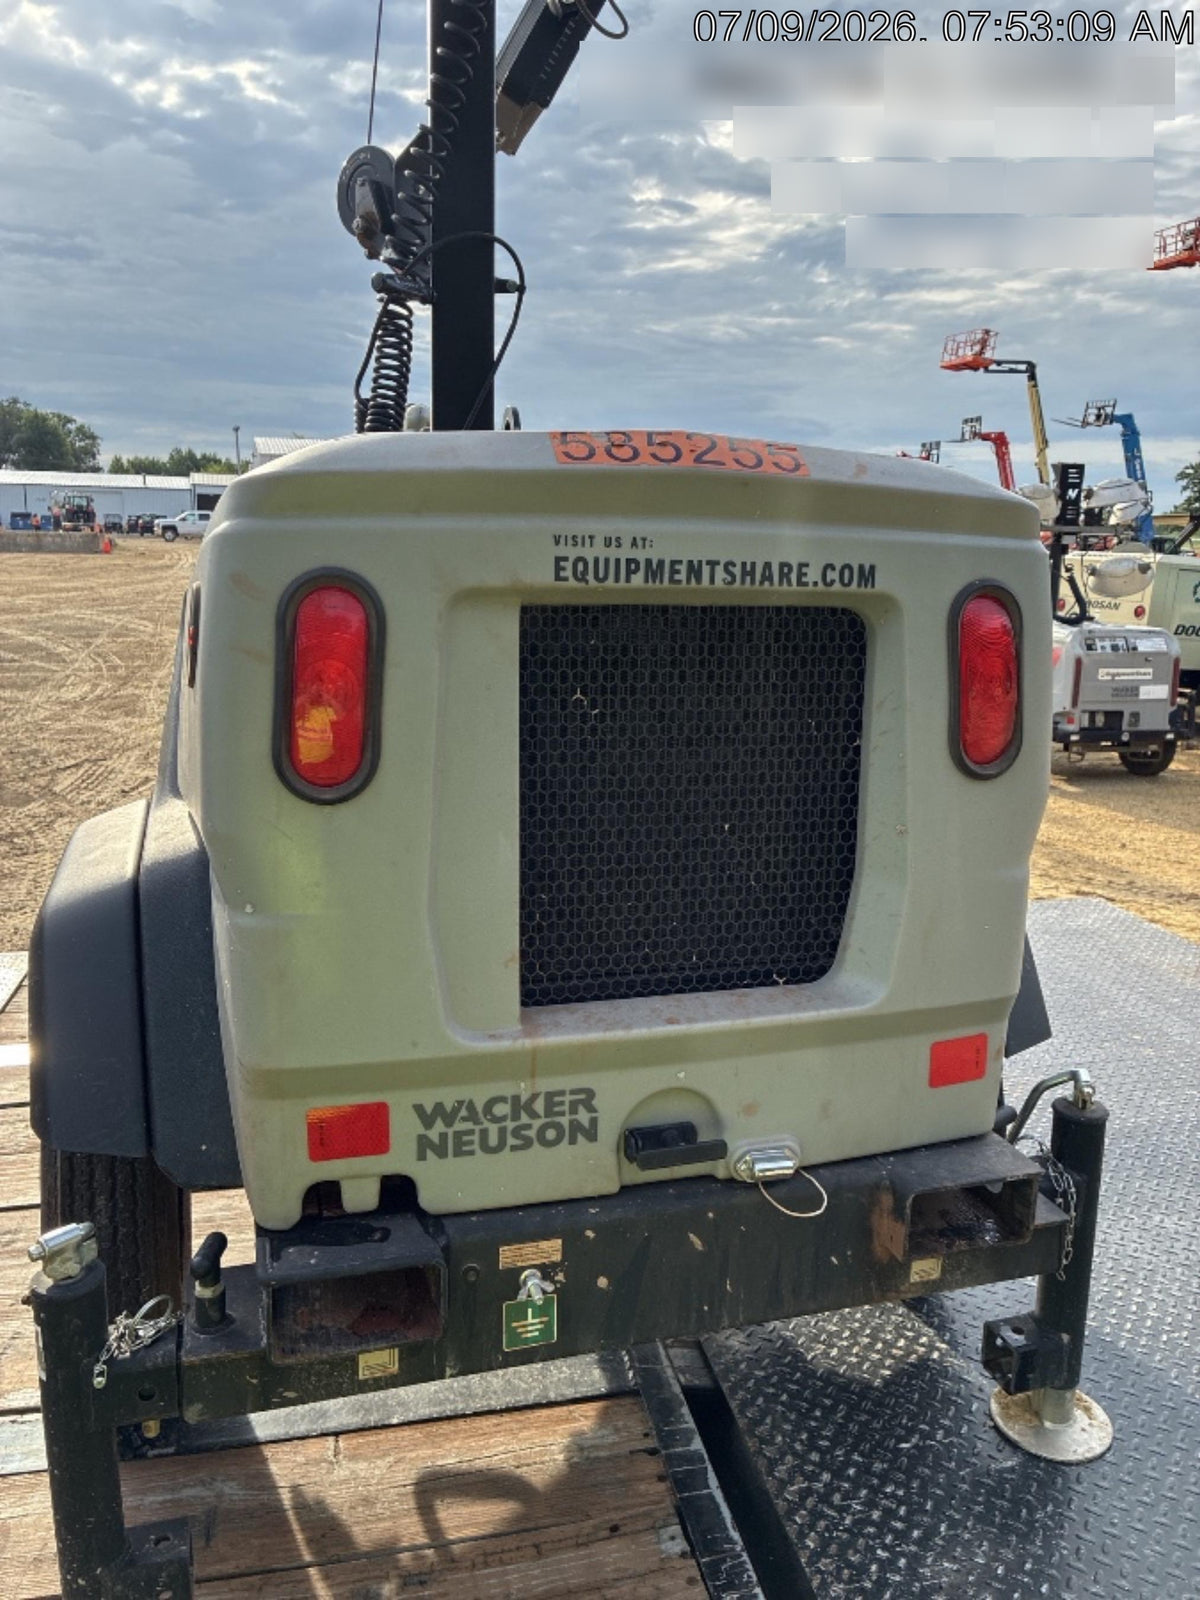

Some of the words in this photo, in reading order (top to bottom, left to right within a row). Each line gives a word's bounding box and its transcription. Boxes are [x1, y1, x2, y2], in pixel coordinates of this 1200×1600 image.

[560, 431, 802, 473] 585255
[553, 534, 596, 548] VISIT
[603, 536, 623, 549] US
[630, 537, 654, 550] AT:
[553, 555, 877, 588] EQUIPMENTSHARE.COM
[1087, 600, 1121, 611] OSAN
[412, 1087, 598, 1131] WACKER
[416, 1115, 599, 1162] NEUSON
